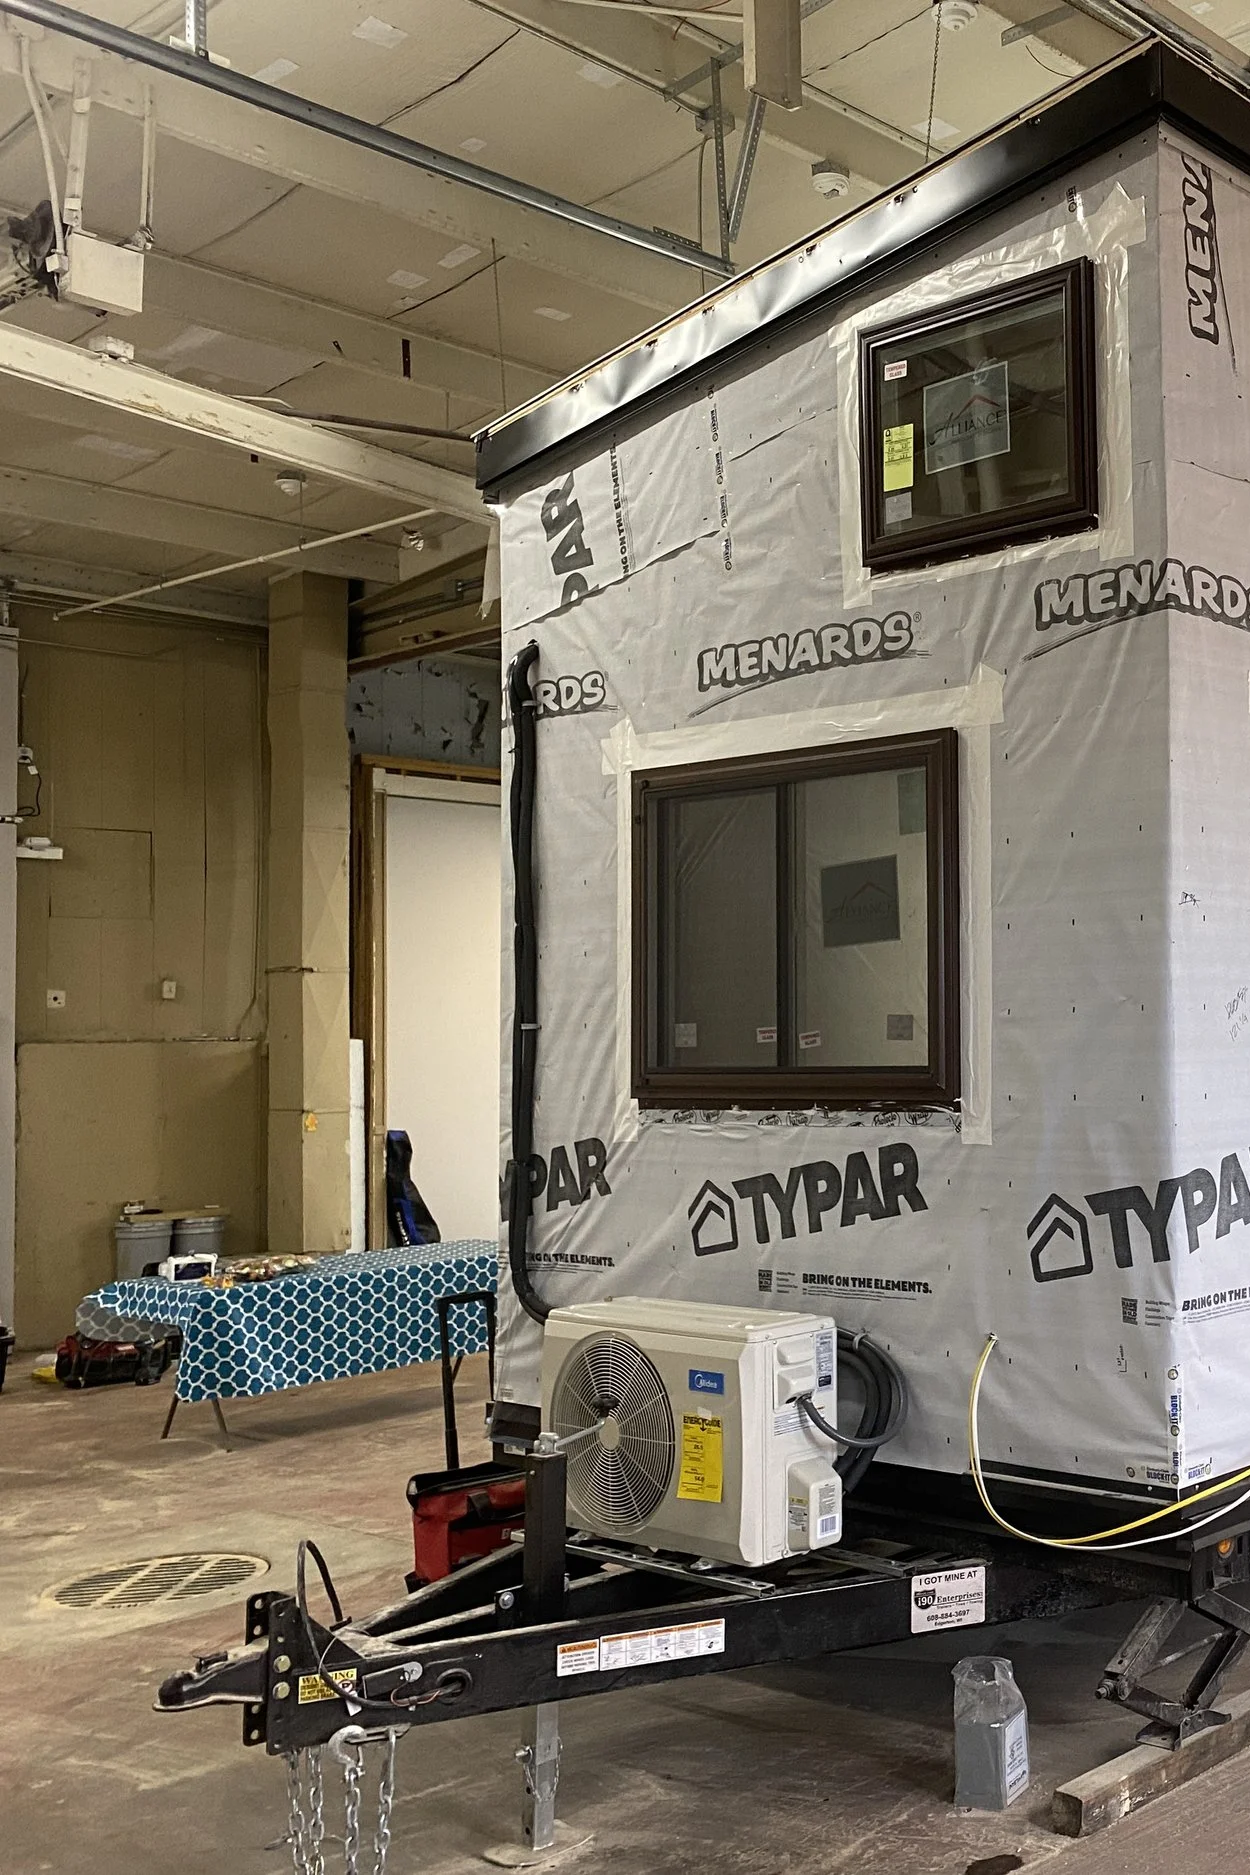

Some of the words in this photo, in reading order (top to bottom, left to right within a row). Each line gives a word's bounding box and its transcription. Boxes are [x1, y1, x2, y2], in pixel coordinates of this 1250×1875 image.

[694, 612, 914, 692] MENARDS
[732, 1142, 928, 1244] TYPAR
[802, 1273, 834, 1286] BRING
[835, 1275, 849, 1288] ON
[851, 1277, 873, 1289] THE
[874, 1279, 932, 1293] ELEMENTS.
[1182, 1296, 1212, 1312] BRING
[1213, 1292, 1227, 1305] ON
[1229, 1288, 1247, 1302] THE
[924, 1576, 942, 1585] GOT
[944, 1572, 965, 1582] MINE
[967, 1570, 977, 1579] AT
[918, 1595, 933, 1607] i90
[937, 1592, 981, 1603] Enterprises
